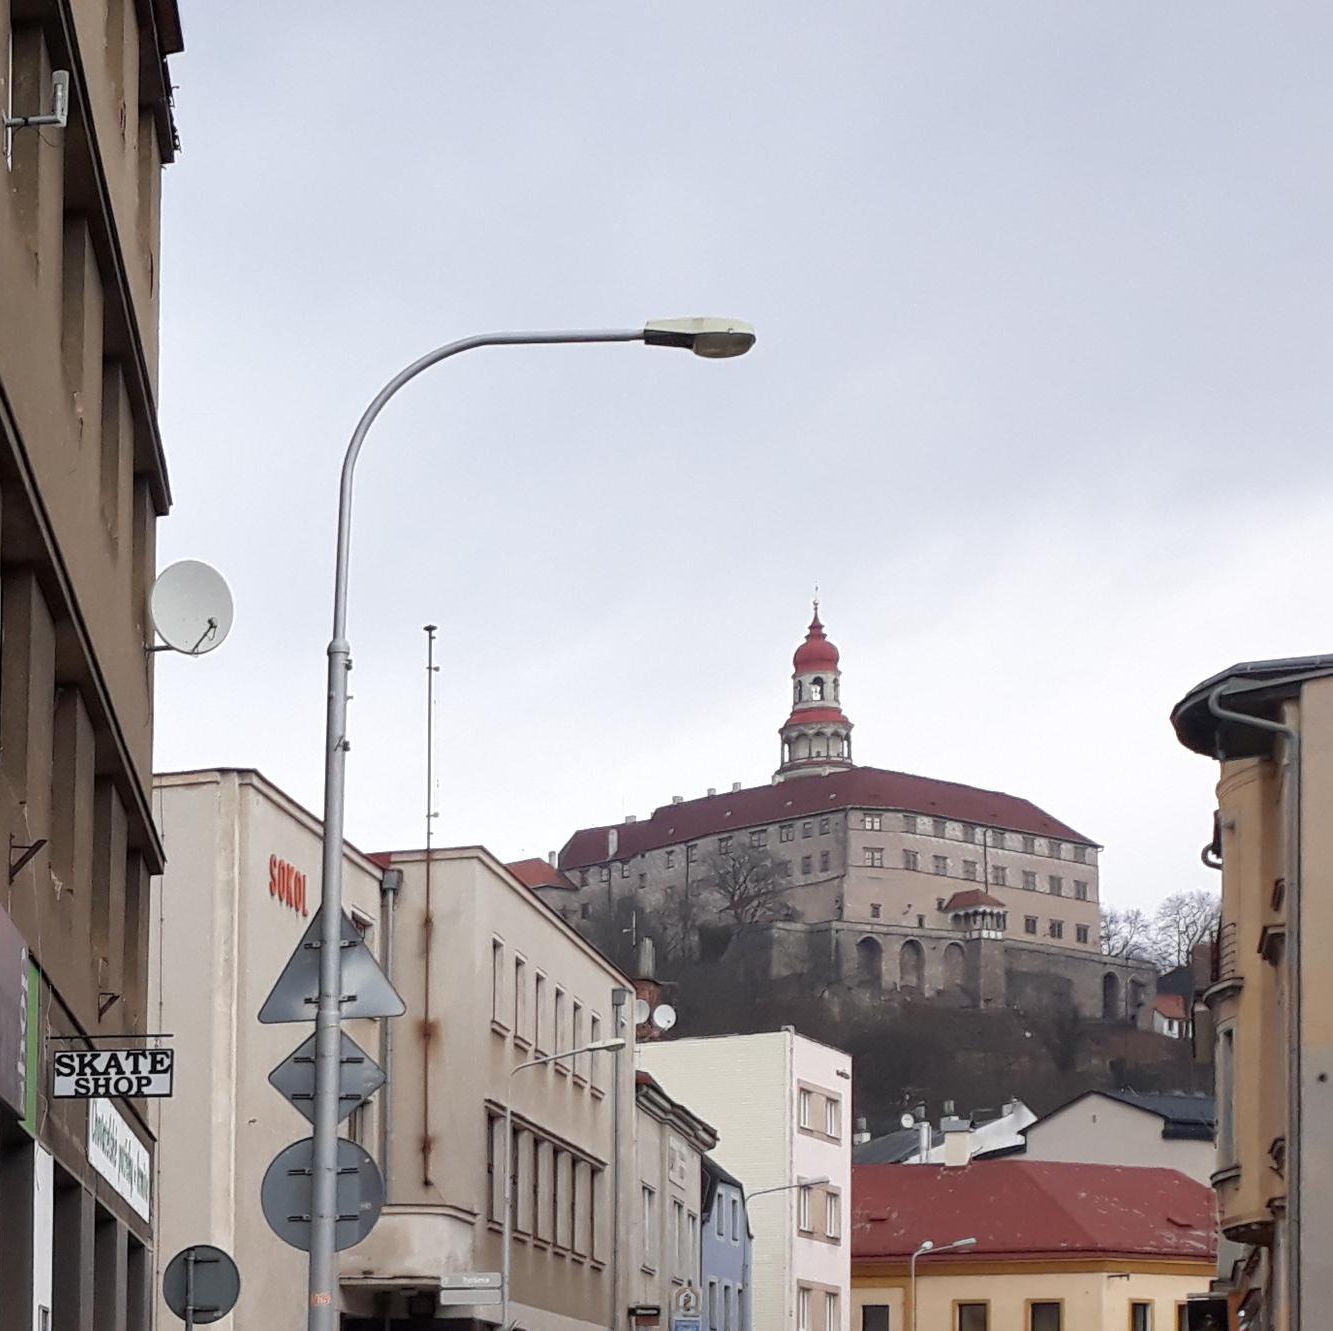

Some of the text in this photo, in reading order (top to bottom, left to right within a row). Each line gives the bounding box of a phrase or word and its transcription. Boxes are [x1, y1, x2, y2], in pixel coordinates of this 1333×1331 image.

[269, 853, 309, 918] SOKOL
[55, 1050, 172, 1078] SKATE
[74, 1075, 153, 1096] SHOP
